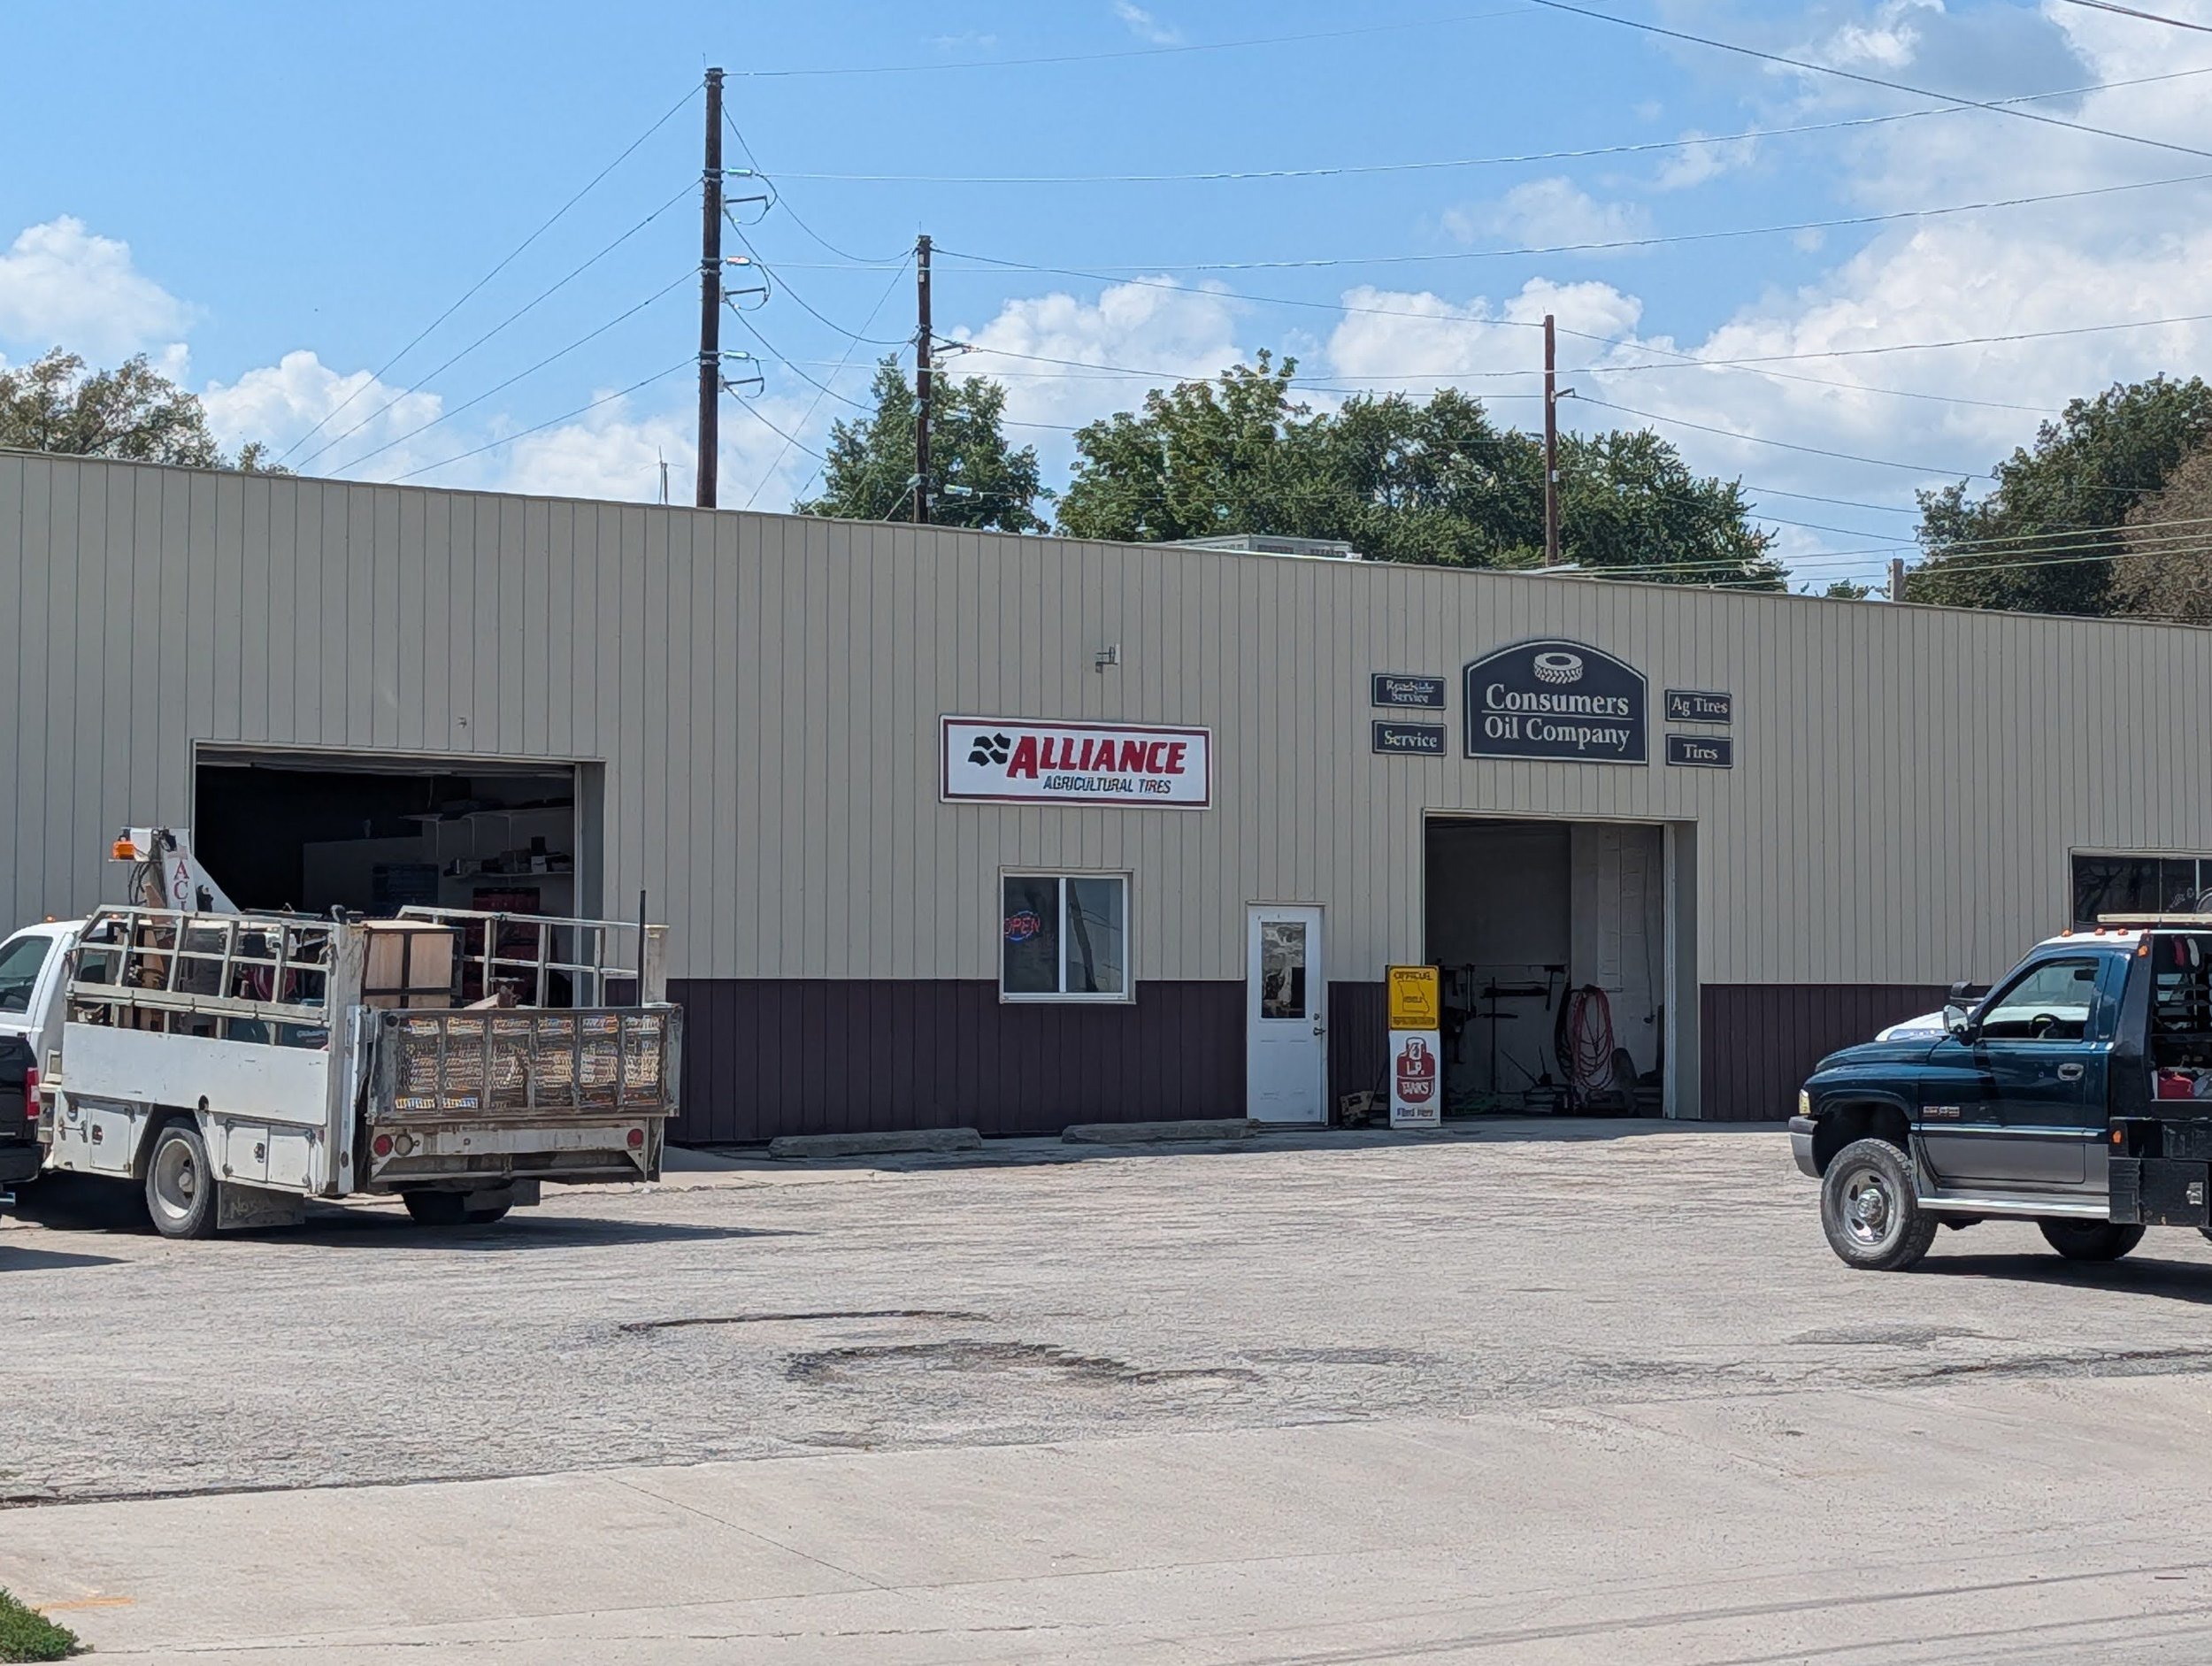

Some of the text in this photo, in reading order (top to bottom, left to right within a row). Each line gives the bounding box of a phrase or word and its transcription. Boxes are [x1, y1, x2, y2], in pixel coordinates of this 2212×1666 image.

[1486, 683, 1630, 715] Consumers
[1671, 696, 1728, 717] Ag Tires
[1385, 730, 1438, 748] Service
[1485, 716, 1631, 751] Oil Company
[1006, 735, 1187, 779] ALLIANCE
[1683, 744, 1718, 761] Tires
[1043, 775, 1171, 794] AGRICULTURAL TIRES
[1004, 917, 1040, 934] OPEN
